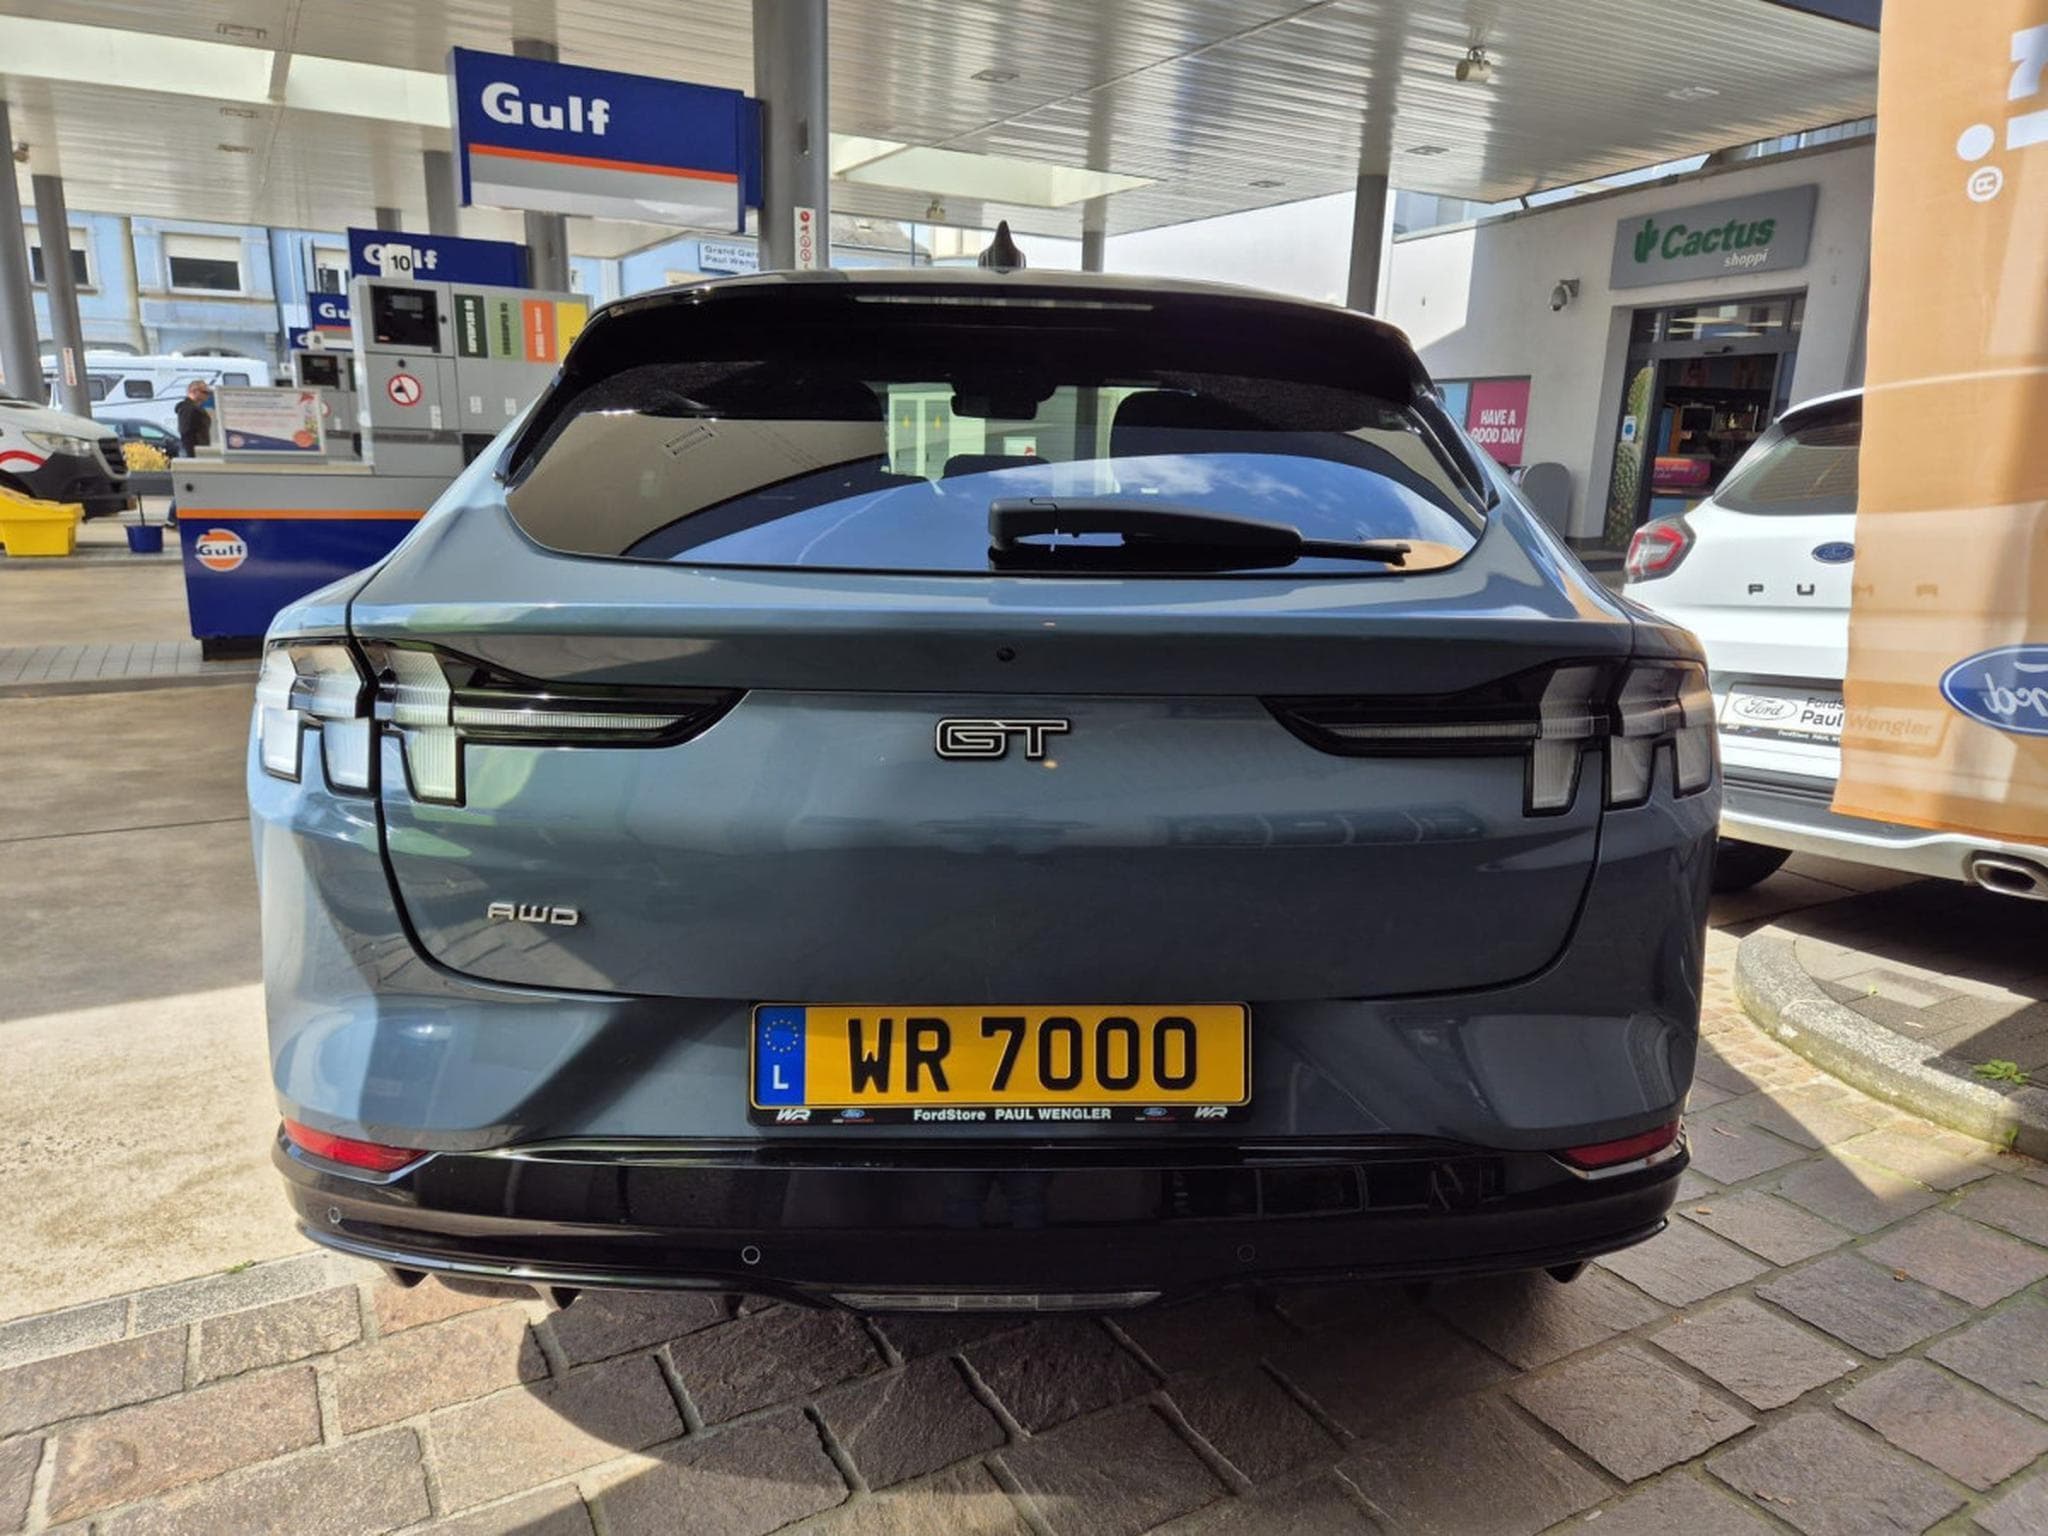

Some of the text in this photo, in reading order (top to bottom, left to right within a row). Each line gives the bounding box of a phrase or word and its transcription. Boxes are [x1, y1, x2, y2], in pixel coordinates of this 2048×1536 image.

[481, 81, 610, 136] Gulf
[1661, 218, 1776, 259] Cactus
[704, 245, 736, 256] Grand
[1723, 249, 1769, 268] shoppi
[391, 255, 411, 271] 10
[1481, 409, 1516, 426] HAVE A
[1471, 427, 1523, 444] GOOD DAY
[199, 543, 242, 556] Gulf
[1800, 709, 1844, 727] Paul
[936, 718, 1069, 758] GT
[488, 902, 579, 926] AWD
[848, 1016, 1197, 1093] WR 7000
[773, 1065, 789, 1090] L
[776, 1108, 811, 1121] WR
[913, 1107, 1112, 1121] FordStore PAUL WENGLER
